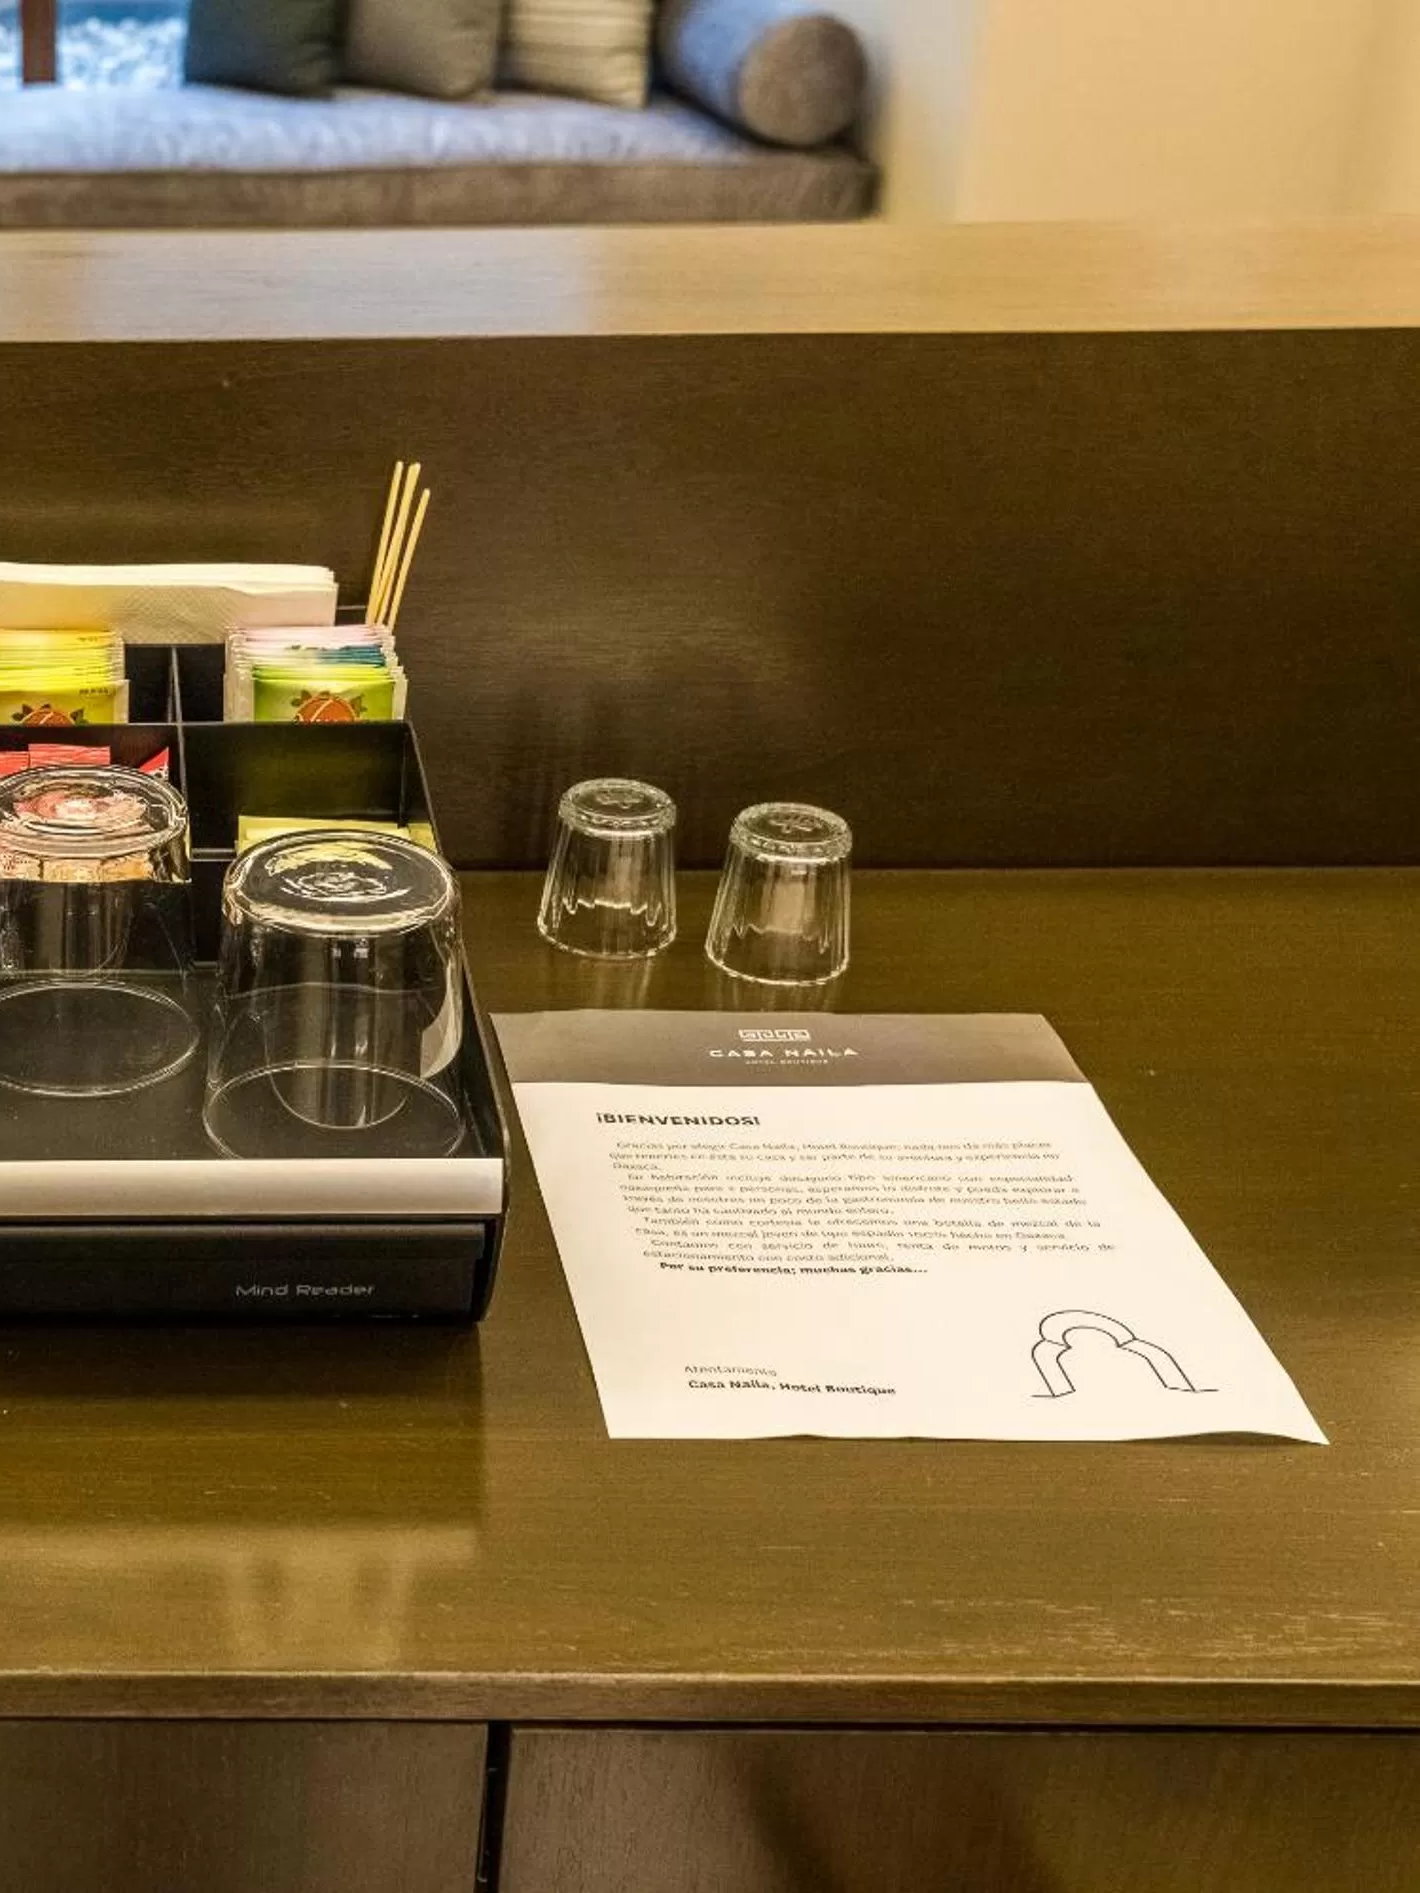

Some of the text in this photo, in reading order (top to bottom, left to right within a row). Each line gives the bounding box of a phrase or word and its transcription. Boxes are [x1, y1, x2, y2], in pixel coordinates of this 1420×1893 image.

[784, 1048, 859, 1057] NAILA
[596, 1112, 761, 1126] ¡BIENVENIDOS!
[235, 1284, 376, 1296] Mind Reader
[688, 1379, 726, 1389] Casa
[779, 1382, 821, 1393] Hotel
[825, 1384, 896, 1396] Boutique
